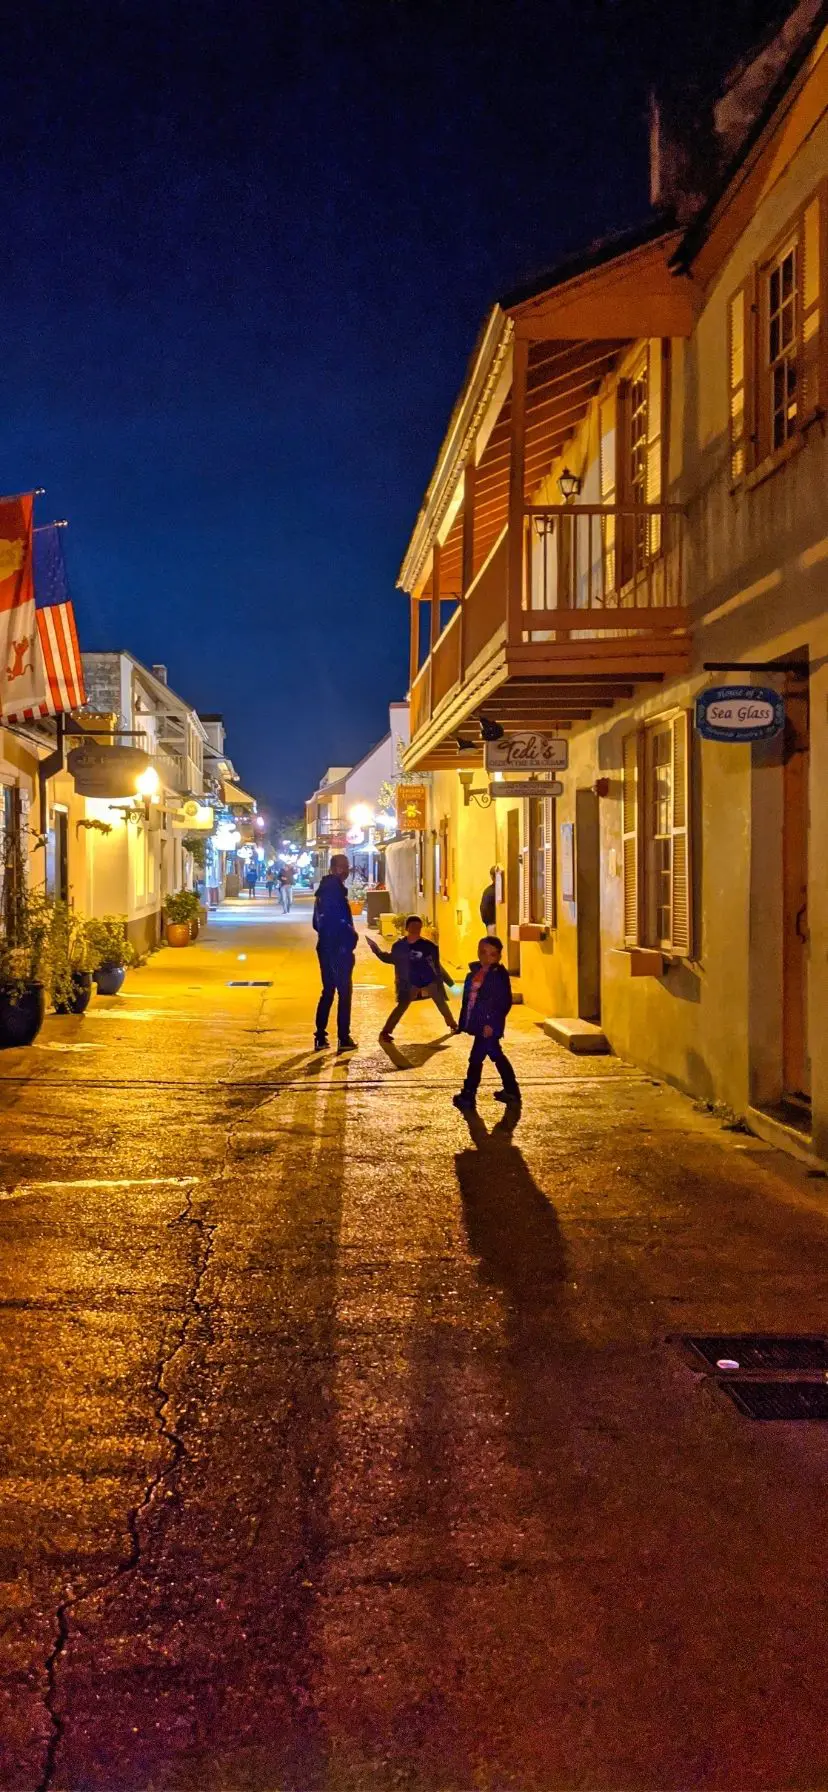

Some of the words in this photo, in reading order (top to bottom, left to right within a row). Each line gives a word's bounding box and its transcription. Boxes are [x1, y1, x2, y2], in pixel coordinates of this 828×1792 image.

[710, 706, 733, 720] Sea
[737, 705, 771, 722] Glass
[497, 736, 556, 764] Tedi's
